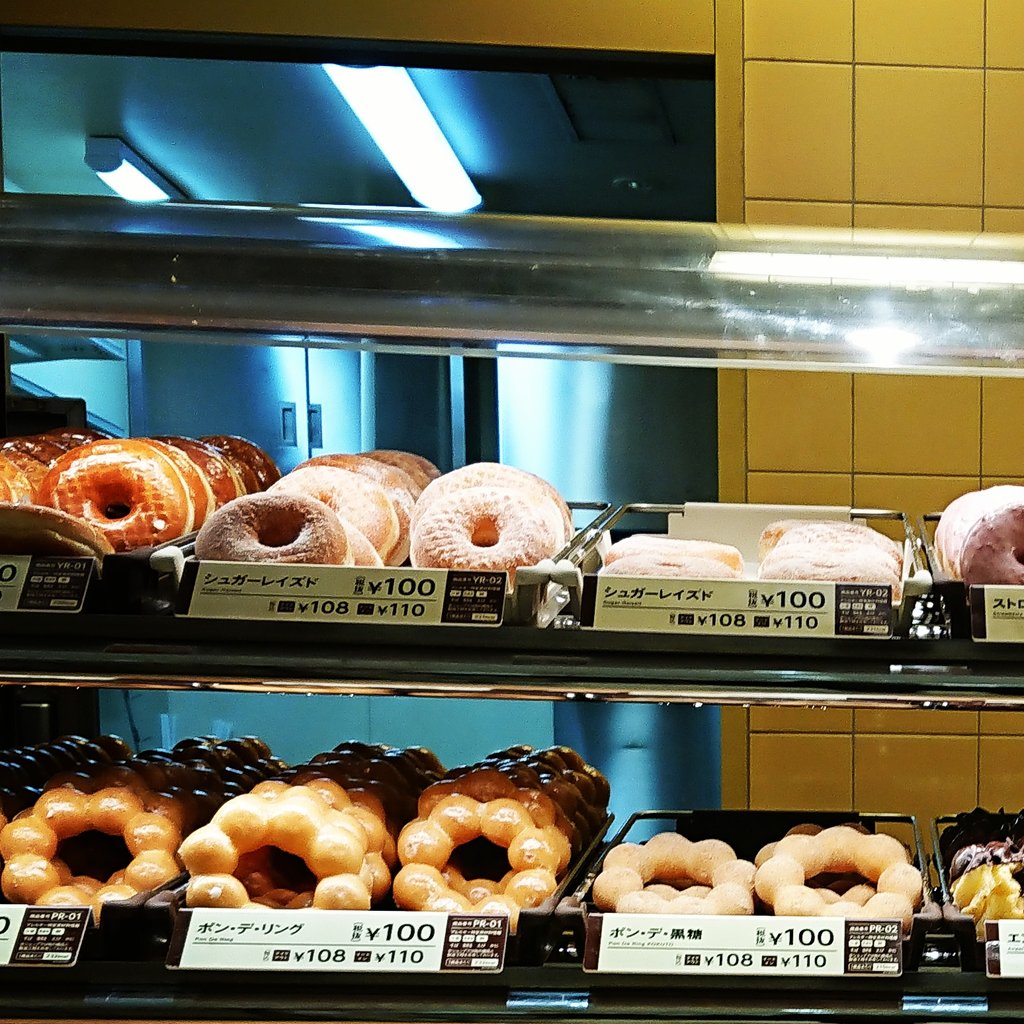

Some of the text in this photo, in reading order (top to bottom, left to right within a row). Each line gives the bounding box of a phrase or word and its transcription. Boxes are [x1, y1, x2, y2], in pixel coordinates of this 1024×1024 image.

[203, 573, 319, 589] シュガーレイズド
[367, 577, 437, 596] ¥100
[604, 586, 714, 602] シュガーレイズド
[761, 590, 827, 609] ¥100
[298, 600, 349, 615] ¥108
[377, 603, 425, 617] ¥110
[698, 613, 746, 628] ¥108
[773, 615, 819, 629] ¥110
[51, 911, 82, 921] PR-01
[197, 922, 305, 936] ポン・デ・リング
[473, 919, 503, 929] PR-01
[365, 923, 436, 943] ¥100
[608, 927, 703, 941] ポン・デ・黒糖
[769, 928, 835, 947] ¥100
[294, 949, 347, 963] ¥108
[376, 950, 424, 964] ¥110
[703, 953, 753, 967] ¥108
[781, 954, 828, 968] ¥110
